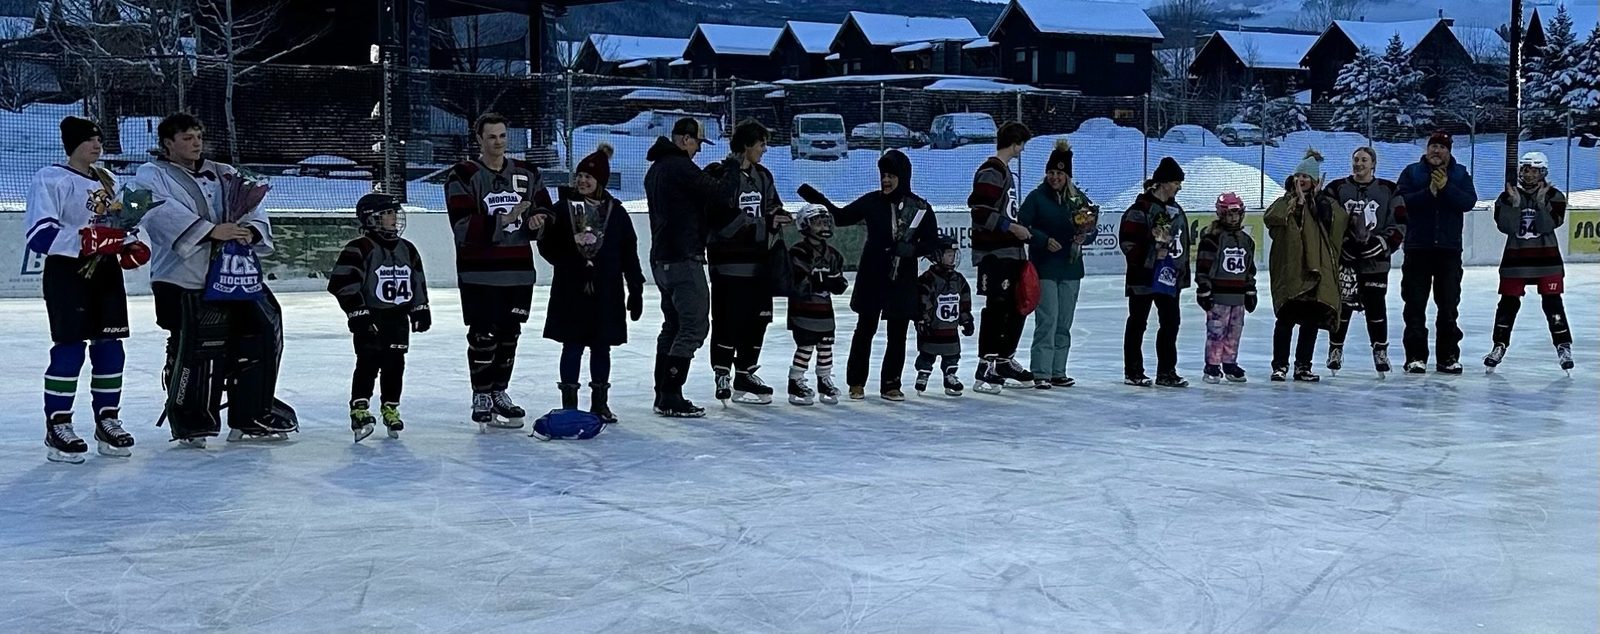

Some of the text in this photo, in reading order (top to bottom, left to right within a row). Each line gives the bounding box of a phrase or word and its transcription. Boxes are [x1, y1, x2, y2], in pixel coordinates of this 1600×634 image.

[512, 174, 528, 193] C
[1097, 224, 1115, 233] SKY
[220, 253, 259, 274] ICE
[1226, 257, 1246, 271] 64
[219, 275, 259, 286] HOCKEY
[381, 279, 411, 301] 64
[940, 304, 959, 320] 64
